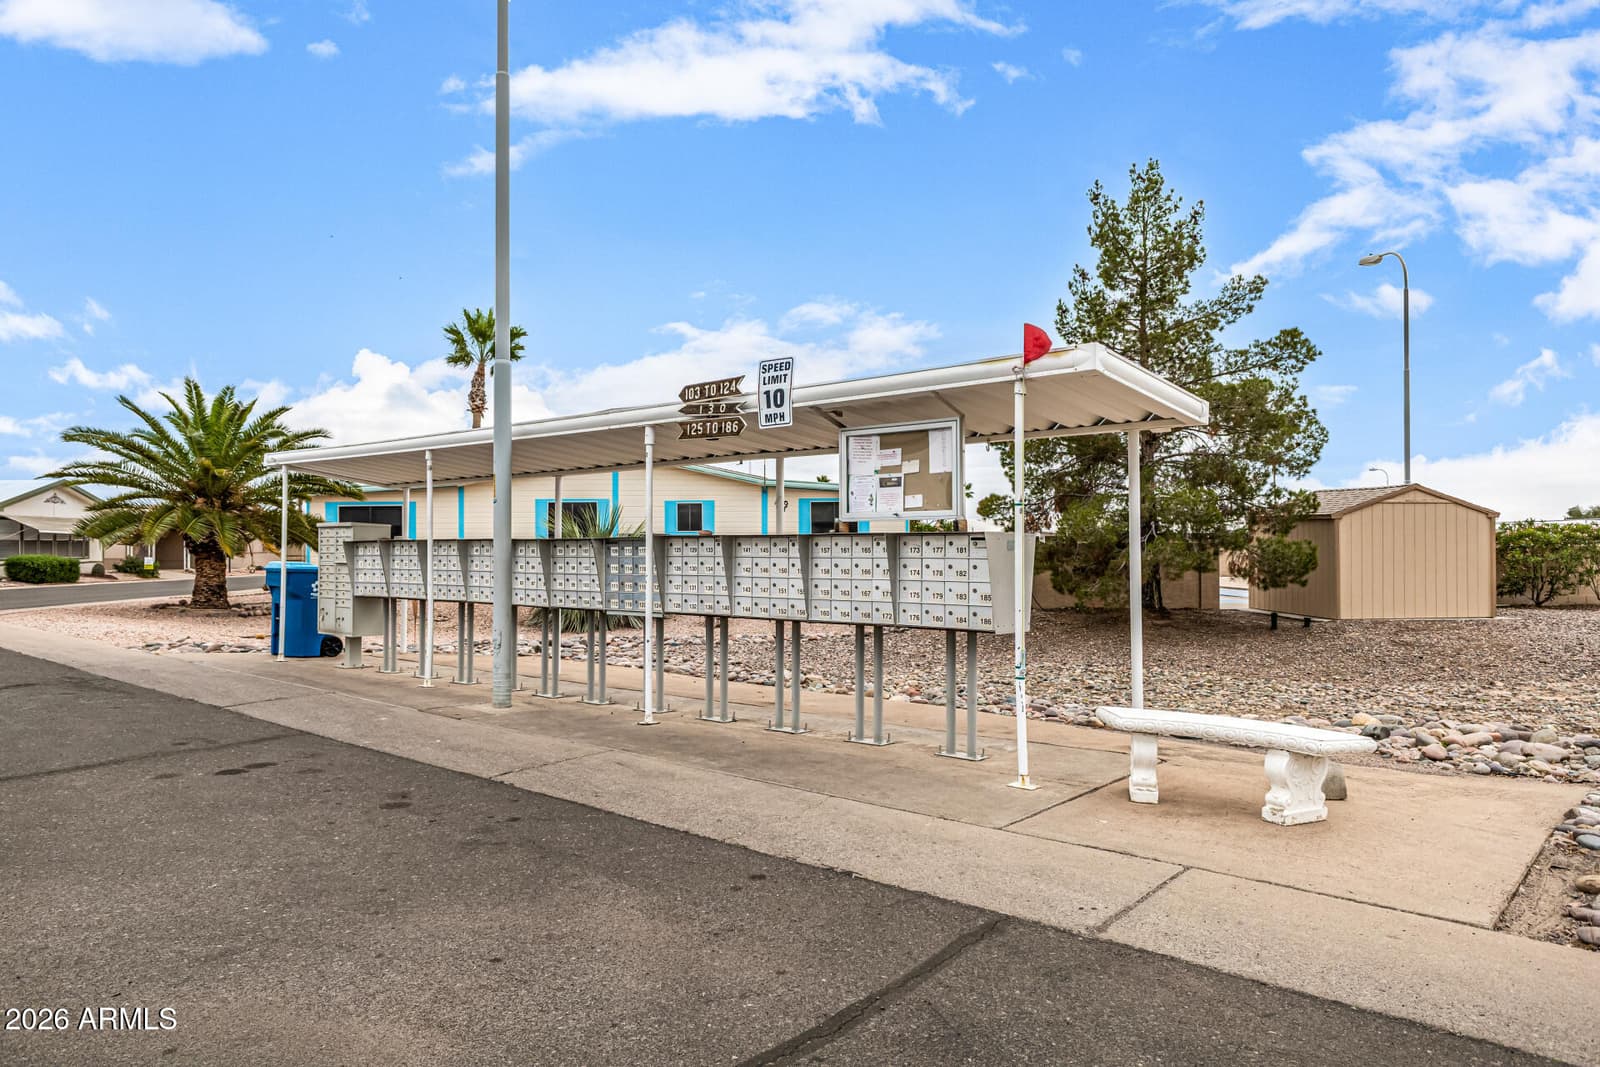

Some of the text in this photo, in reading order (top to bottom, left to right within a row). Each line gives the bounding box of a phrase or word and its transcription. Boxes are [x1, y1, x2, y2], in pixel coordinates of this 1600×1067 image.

[762, 361, 790, 374] SPEED
[763, 374, 788, 385] LIMIT
[686, 380, 736, 400] 103 TO 124
[764, 388, 785, 408] 10
[765, 412, 785, 423] MPH
[688, 421, 738, 435] 125 TO 186
